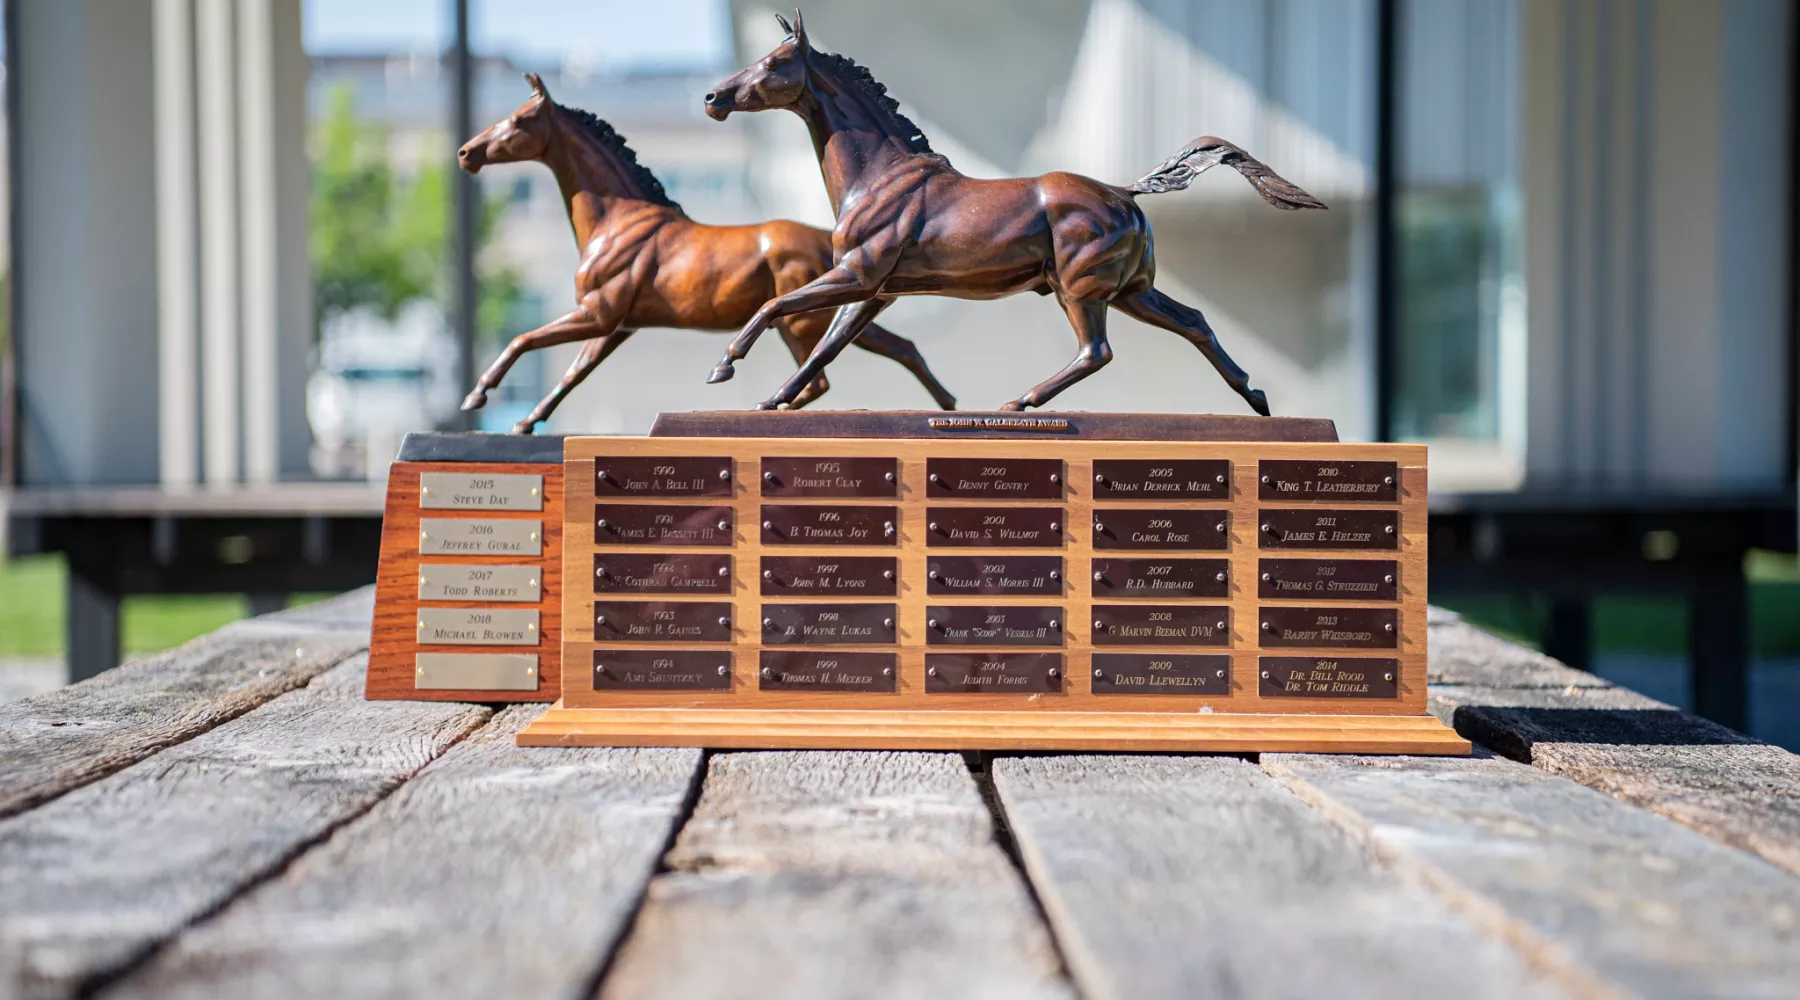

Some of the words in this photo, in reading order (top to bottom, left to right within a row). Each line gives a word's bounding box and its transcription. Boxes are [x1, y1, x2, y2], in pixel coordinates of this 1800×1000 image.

[949, 418, 972, 427] JOHN
[653, 466, 675, 475] 1990
[815, 463, 840, 472] 1995
[1318, 468, 1338, 476] 2010
[1148, 469, 1173, 477] 2005
[623, 479, 648, 489] JOHN
[666, 480, 688, 489] BELL
[692, 480, 704, 489] III
[793, 477, 832, 487] ROBERT
[836, 477, 862, 487] CLAY
[958, 480, 989, 489] DENNY
[994, 480, 1029, 490] GENTRY
[1110, 481, 1139, 491] BRIAN
[1144, 482, 1181, 491] DERRICK
[1186, 482, 1211, 491] MEHL
[1276, 481, 1299, 491] KING
[1304, 482, 1312, 491] T.
[1316, 482, 1380, 492] LEATHERBURY
[453, 494, 485, 504] STEVE
[489, 495, 509, 505] DAY
[655, 515, 673, 524] 1991
[819, 513, 840, 521] 1996
[983, 516, 1005, 524] 2001
[1148, 520, 1172, 528] 2006
[468, 525, 493, 534] 2016
[616, 527, 644, 538] JAMES
[661, 528, 698, 538] BASSETT
[701, 528, 714, 538] III
[804, 527, 843, 537] THOMAS
[847, 527, 868, 537] JOY
[950, 529, 979, 538] DAVID
[984, 529, 992, 538] S.
[1000, 529, 1039, 539] WILLMOT
[1132, 533, 1160, 542] CAROL
[1167, 533, 1189, 542] ROSE
[1281, 531, 1315, 541] JAMES
[1331, 532, 1371, 541] HELZER
[440, 540, 481, 550] JEFFREY
[488, 541, 521, 550] GURAL
[817, 565, 838, 573] 1997
[983, 565, 1005, 573] 2002
[1147, 566, 1172, 575] 2007
[1316, 567, 1336, 576] 2012
[468, 571, 493, 580] 2017
[671, 576, 717, 587] CAMPBELL
[791, 578, 813, 587] JOHN
[819, 578, 830, 587] M.
[836, 578, 866, 587] LYONS
[945, 578, 980, 587] WILLIAM
[985, 578, 992, 587] S.
[999, 578, 1029, 587] MORRIS
[1032, 578, 1044, 587] III
[1126, 579, 1146, 588] R.D.
[1152, 580, 1194, 589] HUBBARD
[1276, 580, 1312, 590] THOMAS
[1315, 581, 1324, 590] G.
[443, 585, 468, 595] TODD
[474, 586, 517, 596] ROBERTS
[467, 615, 492, 624] 2018
[654, 611, 674, 620] 1993
[819, 613, 839, 621] 1998
[985, 615, 1006, 623] 2003
[1149, 613, 1172, 621] 2008
[1316, 616, 1338, 625] 2013
[627, 624, 651, 634] JOHN
[668, 624, 701, 634] GAINES
[784, 625, 796, 635] D.
[803, 625, 836, 635] WAYNE
[841, 625, 871, 635] LUKAS
[944, 628, 968, 637] FRANK
[1006, 628, 1034, 637] VESSELS
[1036, 628, 1047, 637] III
[1120, 626, 1152, 636] MARVIN
[1191, 627, 1213, 636] DVM
[434, 629, 476, 639] MICHAEL
[483, 630, 524, 640] BLOWEN
[1283, 630, 1317, 639] BARRY
[1321, 630, 1371, 640] WEISBORD
[653, 659, 673, 668] 1994
[816, 660, 837, 668] 1999
[981, 662, 1006, 670] 2004
[1149, 662, 1172, 670] 2009
[1316, 661, 1337, 670] 2014
[624, 672, 644, 682] AMI
[781, 673, 816, 682] THOMAS
[821, 672, 830, 683] H.
[836, 674, 872, 684] MEEKER
[962, 675, 992, 684] JUDITH
[1115, 674, 1145, 685] DAVID
[1149, 675, 1206, 686] LLEWELLYN
[1290, 671, 1305, 680] DR.
[1310, 671, 1333, 680] BILL
[1338, 672, 1364, 681] ROOD
[1285, 681, 1301, 691] DR.
[1306, 681, 1328, 691] TOM
[1331, 682, 1369, 692] RIDDLE
